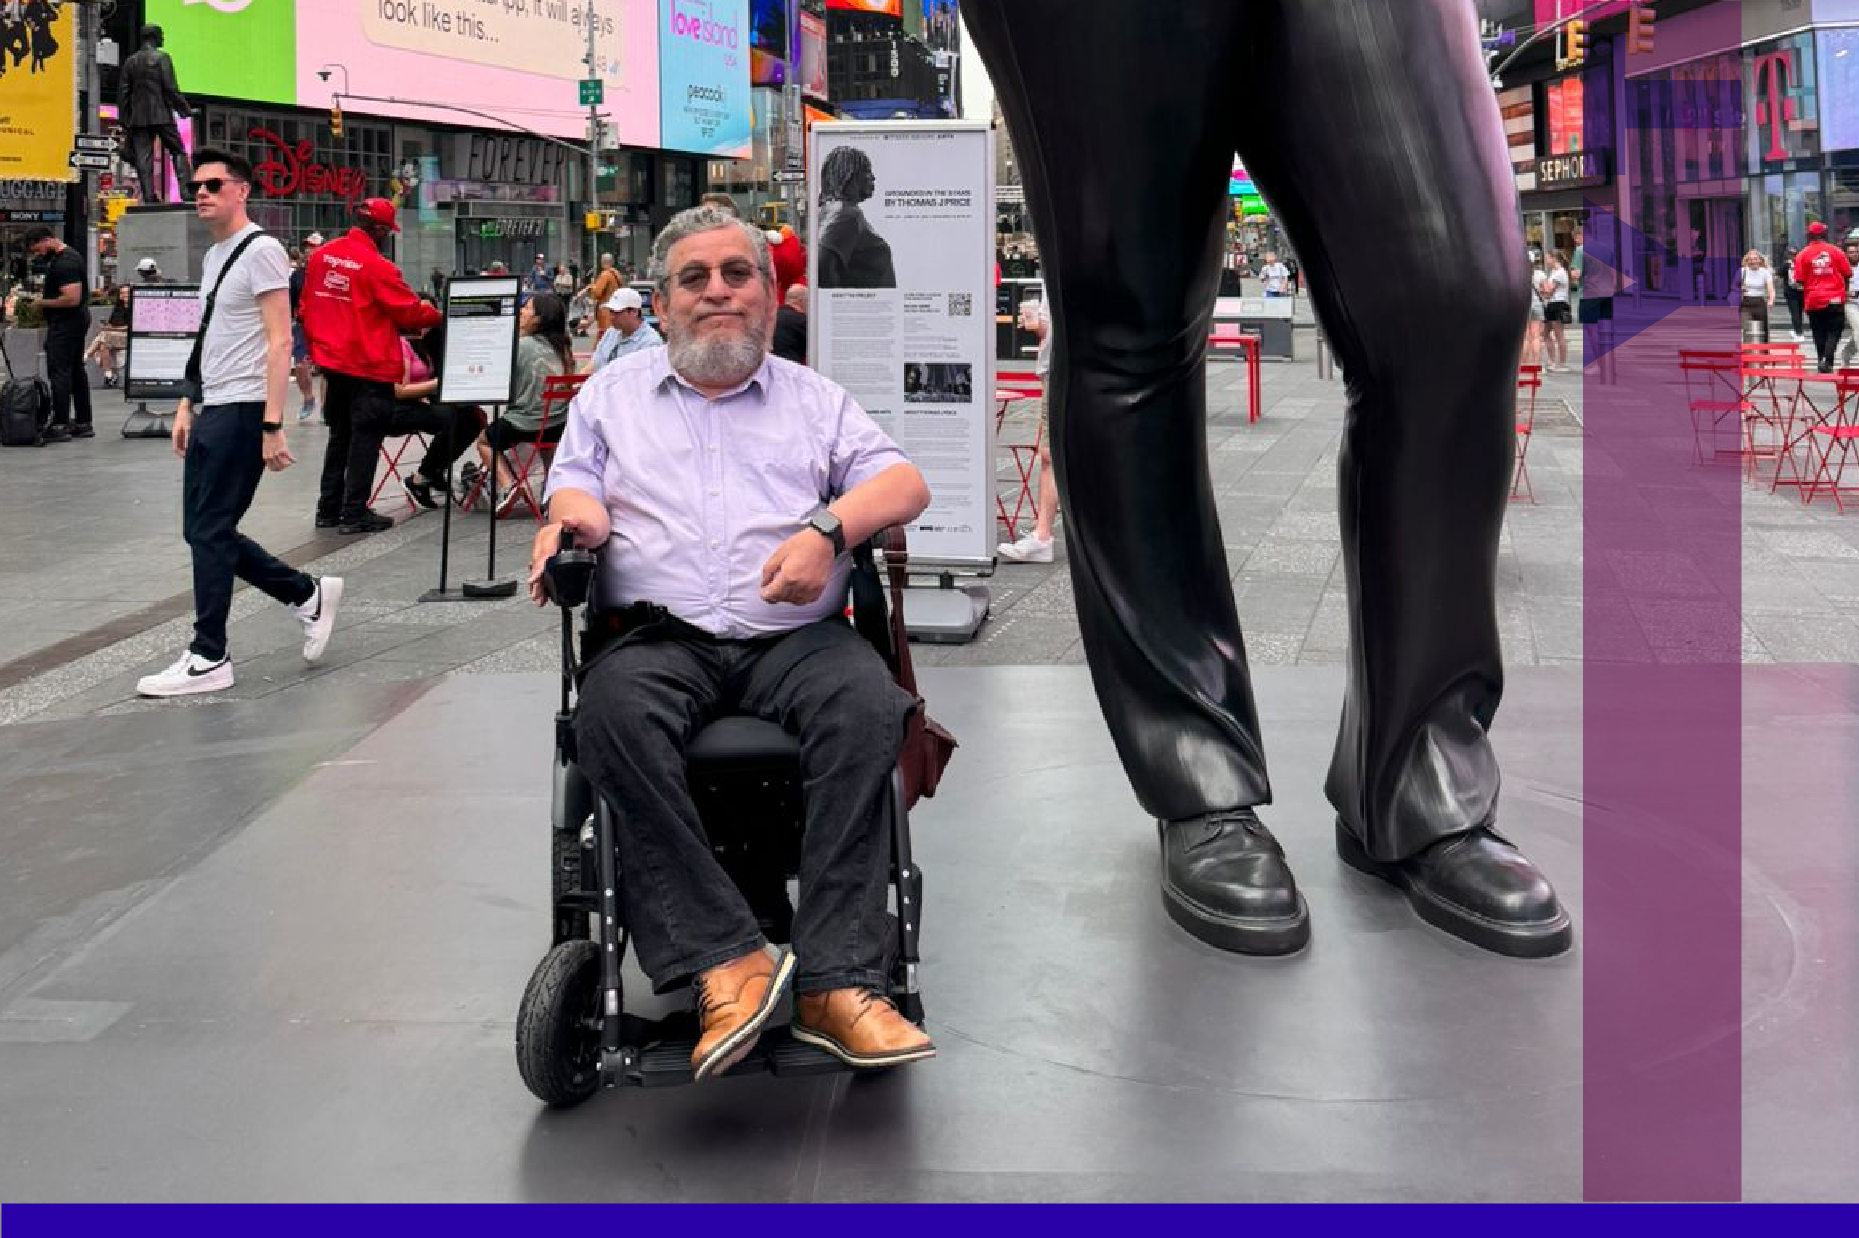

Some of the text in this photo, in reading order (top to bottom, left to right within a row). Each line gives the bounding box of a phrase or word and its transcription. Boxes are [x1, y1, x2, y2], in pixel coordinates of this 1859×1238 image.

[378, 0, 418, 26] look
[422, 2, 451, 33] like
[468, 134, 566, 185] FOREVER
[0, 180, 67, 199] UGGAGE
